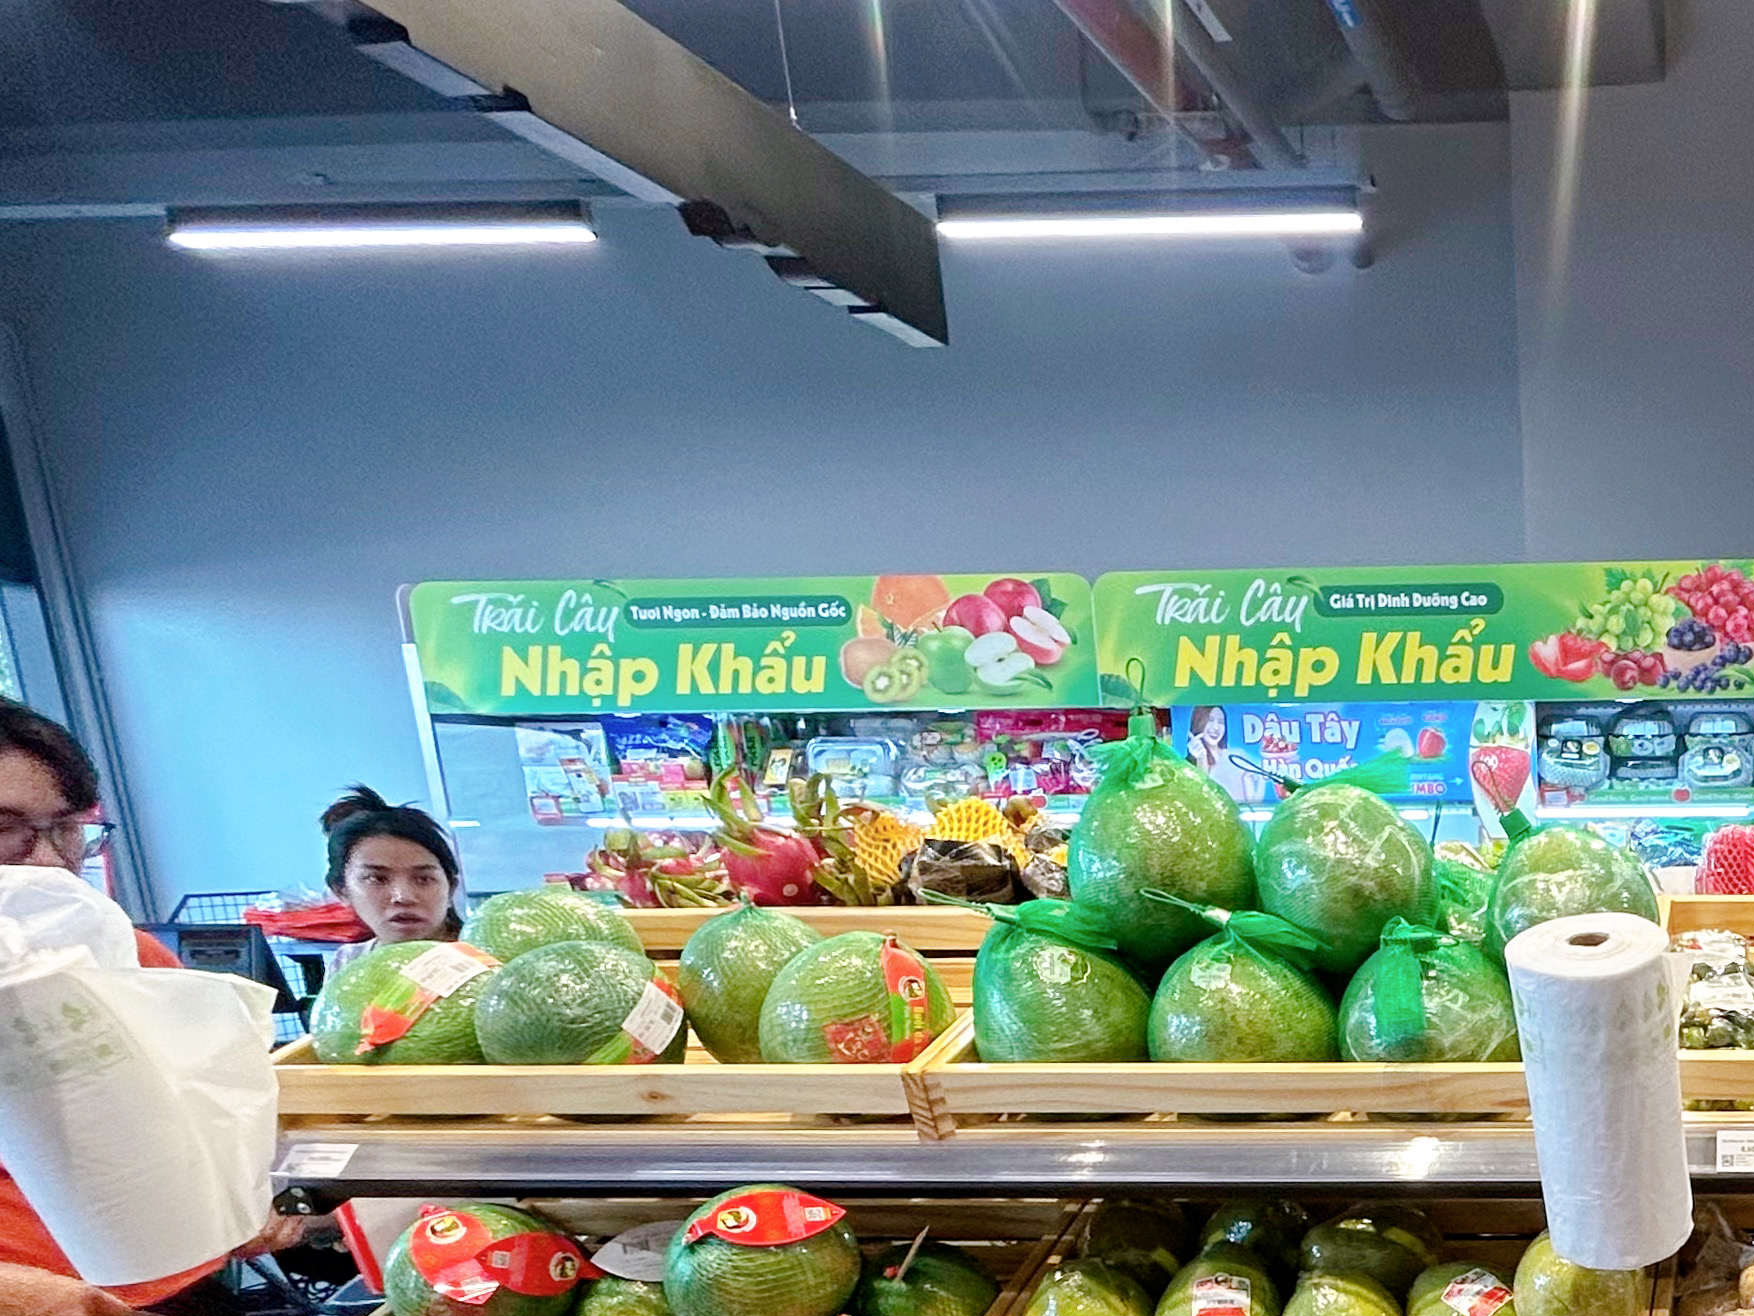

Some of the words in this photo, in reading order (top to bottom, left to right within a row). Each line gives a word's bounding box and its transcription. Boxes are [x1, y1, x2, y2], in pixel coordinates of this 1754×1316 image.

[451, 591, 543, 635] Trái
[554, 588, 620, 643] Cây
[663, 604, 700, 622] Ngon
[742, 601, 769, 619] Bảo
[771, 600, 816, 621] Nguồn
[817, 600, 848, 619] Gốc
[1135, 580, 1231, 626] Trái
[1239, 578, 1309, 633] Cây
[1329, 593, 1355, 609] Giá
[1356, 593, 1376, 611] Trị
[1378, 592, 1410, 608] Dinh
[1461, 591, 1488, 607] Cao
[500, 643, 660, 708] Nhập
[675, 630, 828, 695] Khẩu
[1174, 632, 1341, 698] Nhập
[1355, 617, 1517, 685] Khẩu
[1242, 713, 1301, 744] Dâu
[1305, 710, 1361, 750] Tây
